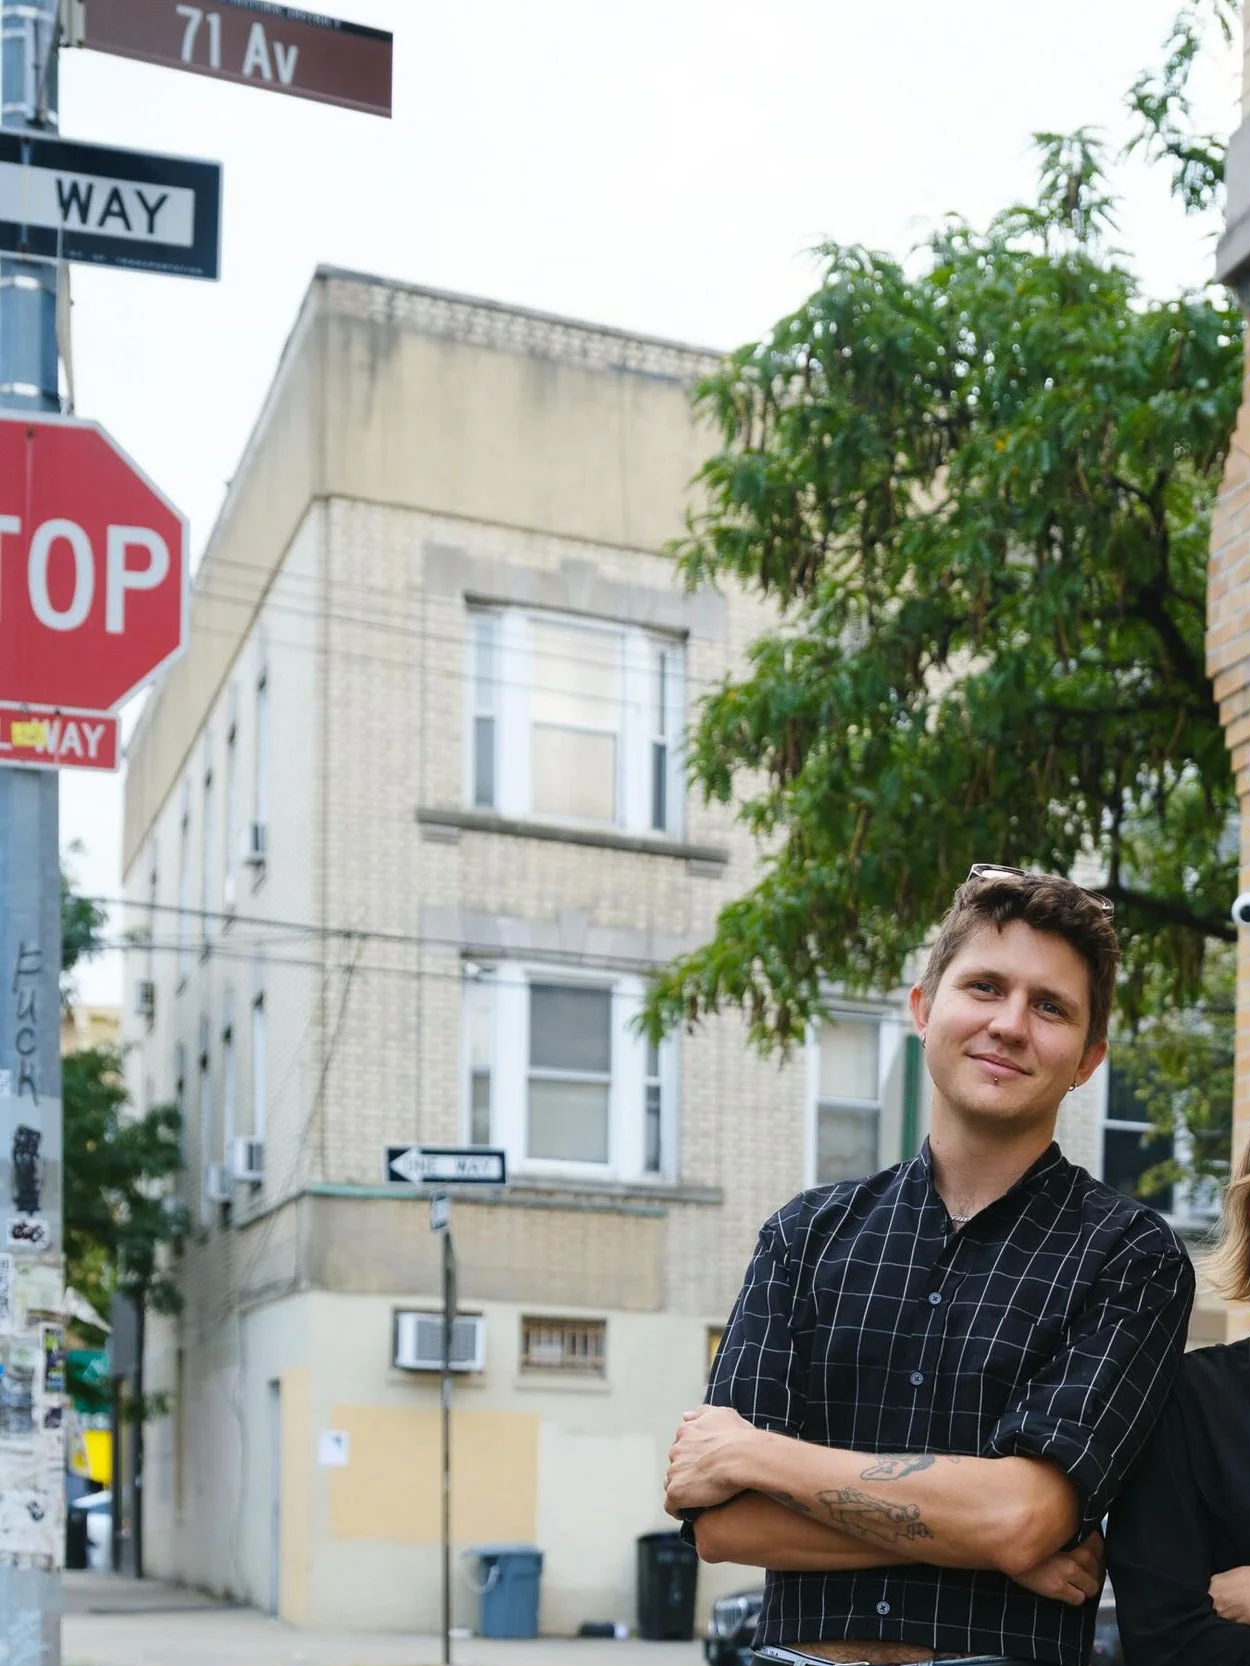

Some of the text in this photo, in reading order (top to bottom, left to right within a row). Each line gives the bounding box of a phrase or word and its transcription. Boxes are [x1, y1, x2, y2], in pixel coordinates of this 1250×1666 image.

[176, 5, 222, 70] 71
[242, 22, 300, 86] Av
[55, 177, 169, 235] WAY
[403, 1155, 490, 1174] ONE WAY
